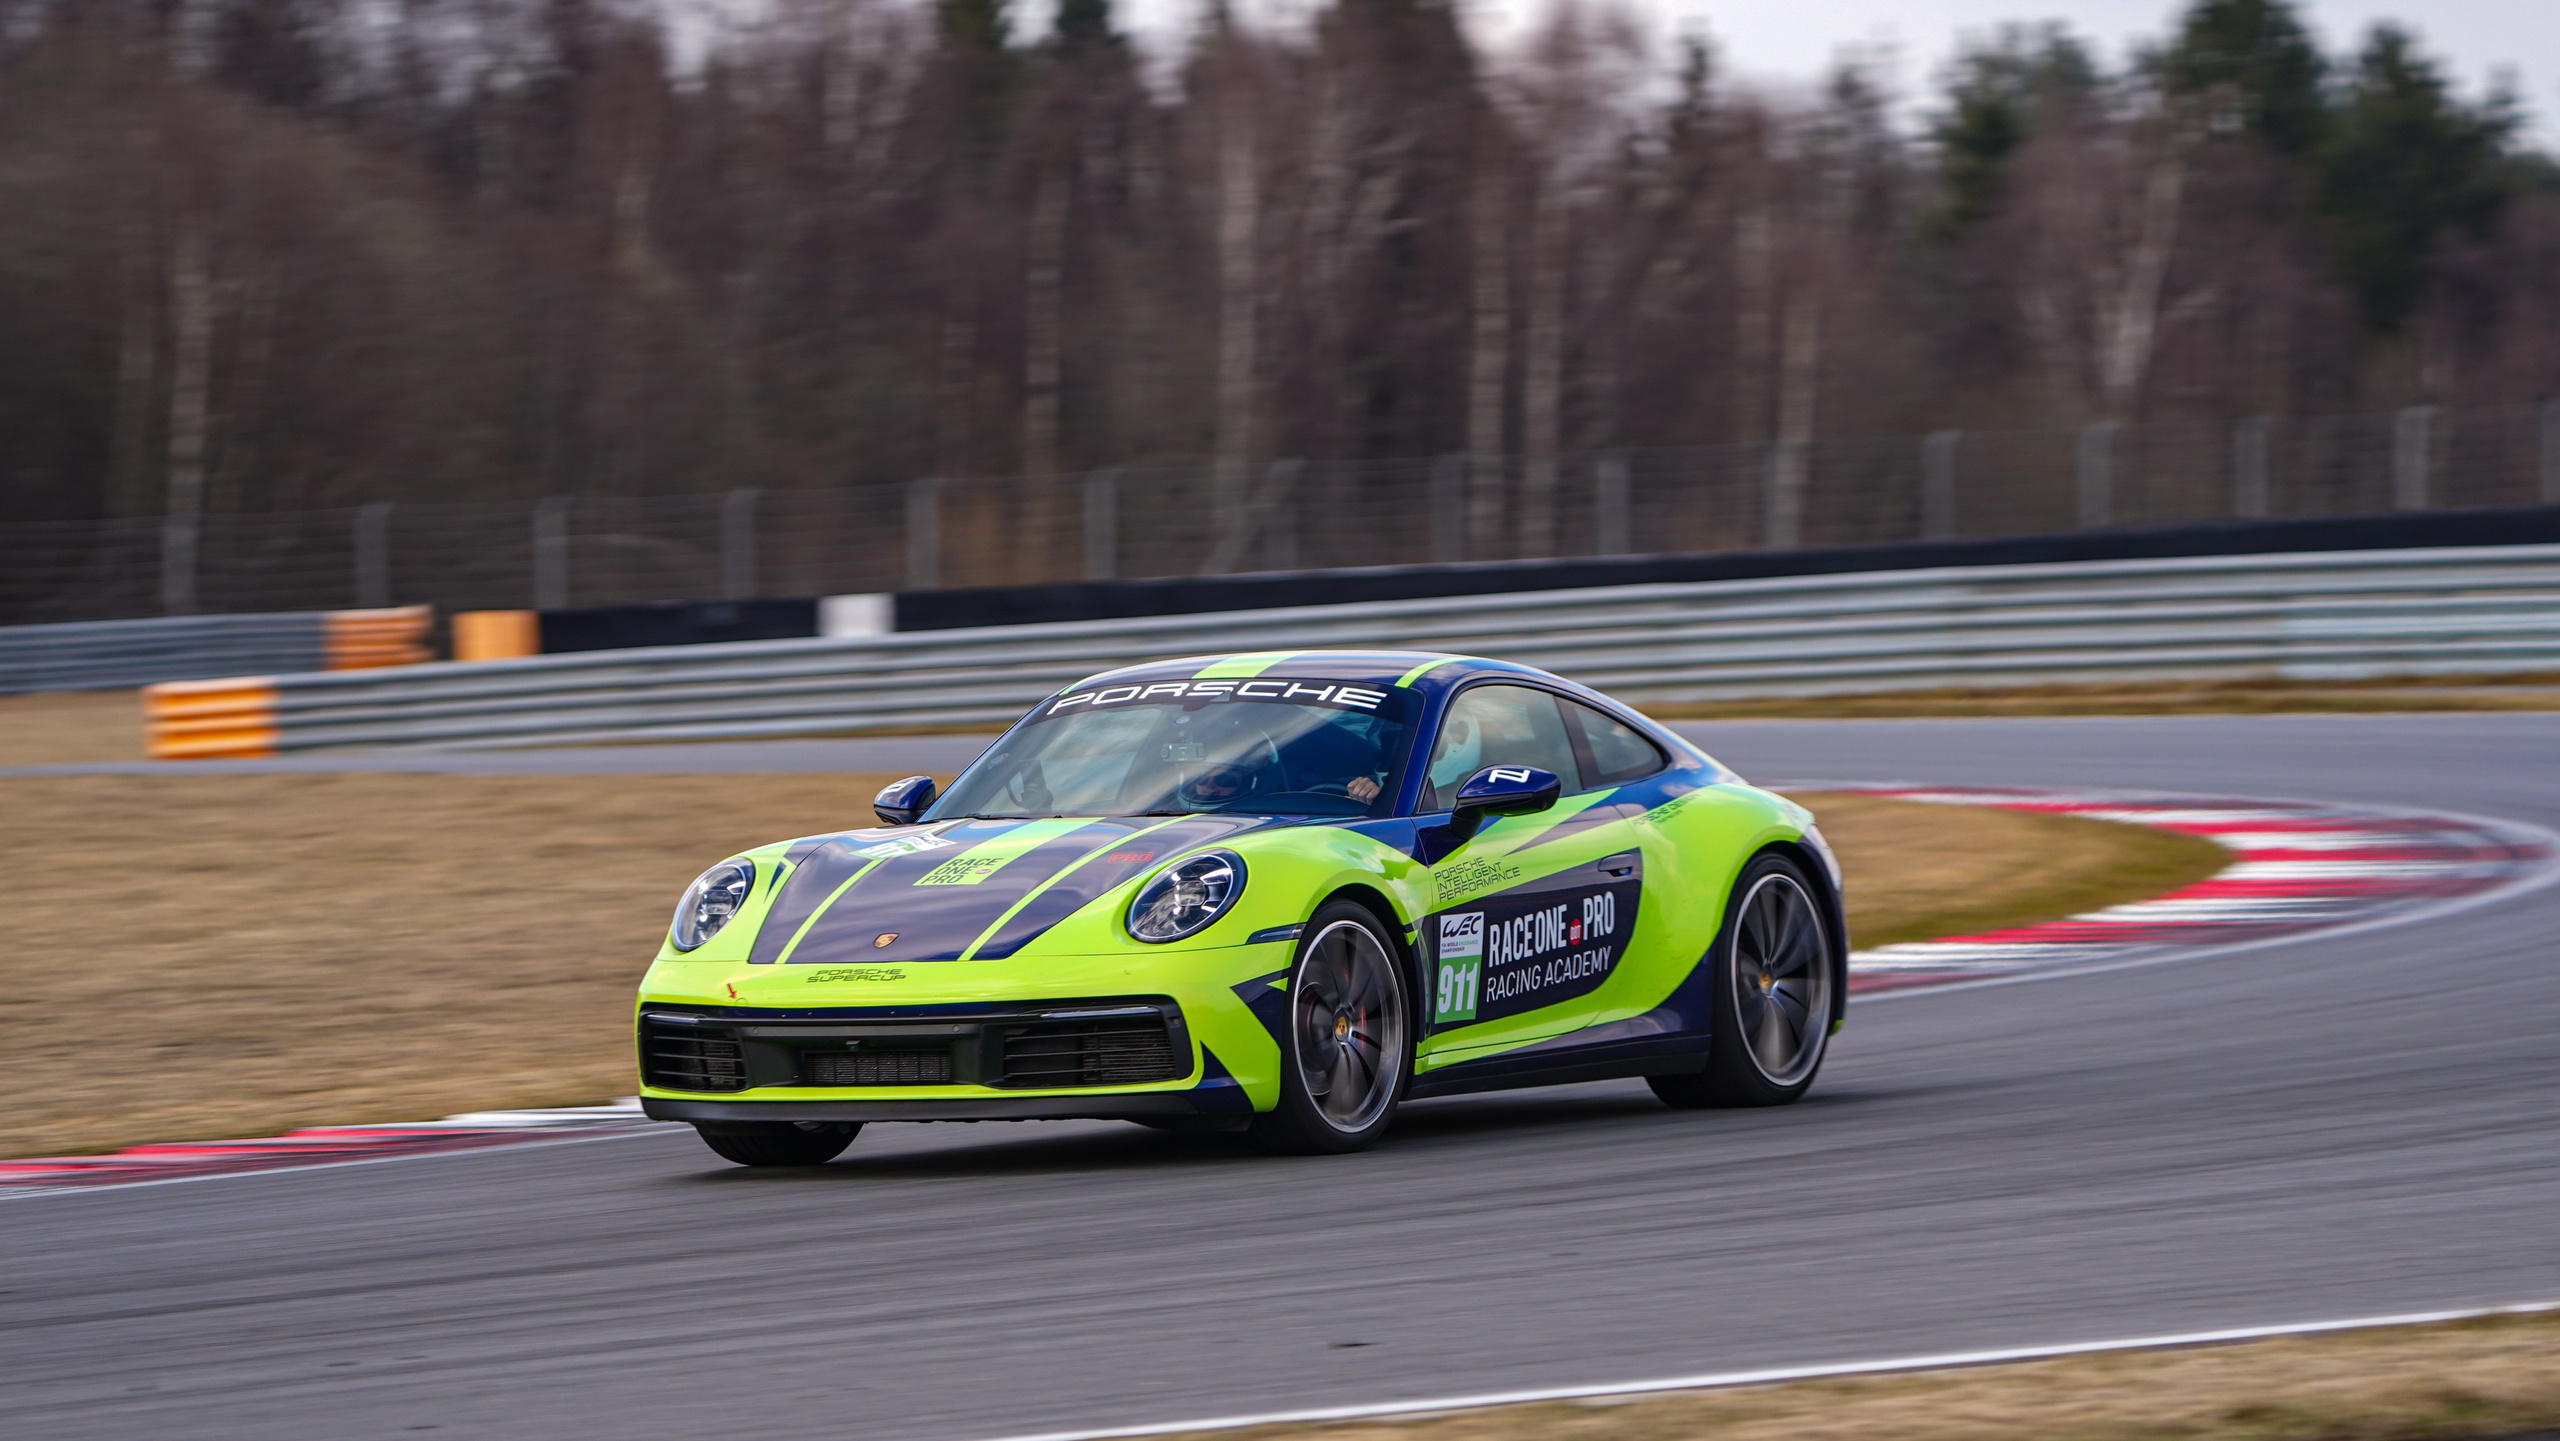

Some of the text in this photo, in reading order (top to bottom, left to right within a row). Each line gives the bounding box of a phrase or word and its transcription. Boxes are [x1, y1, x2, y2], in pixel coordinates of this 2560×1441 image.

[1046, 681, 1388, 715] PORSCHE
[946, 858, 1004, 867] RACE
[1110, 852, 1152, 862] PRO
[920, 874, 965, 884] PRO
[933, 865, 978, 875] ONE
[1434, 857, 1486, 882] PORSCHE
[1437, 861, 1502, 892] INTELLIGENT
[1439, 866, 1521, 903] PERFORMANCE
[1442, 915, 1482, 938] WEC
[1583, 891, 1615, 941] PRO
[806, 974, 907, 983] SUPERCUP
[816, 968, 903, 977] PORSCHE
[1486, 945, 1612, 1003] RACING ACADEMY
[1437, 961, 1479, 1014] 911
